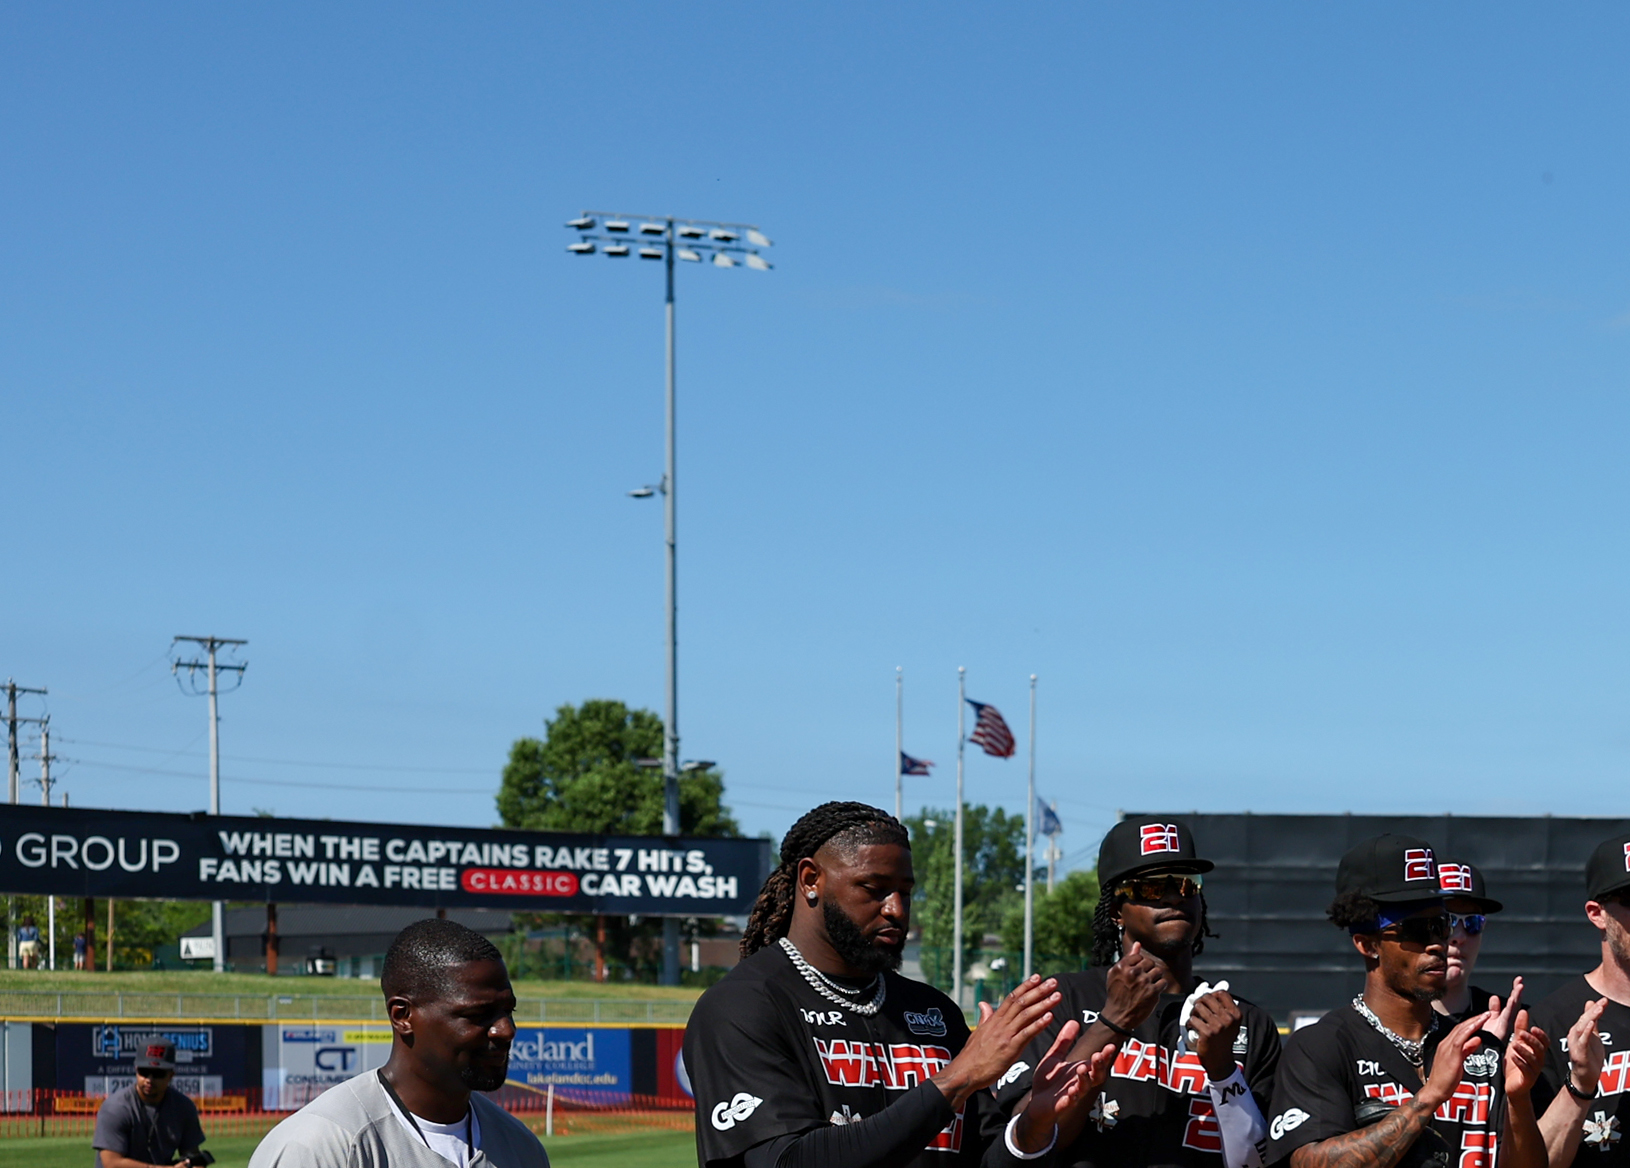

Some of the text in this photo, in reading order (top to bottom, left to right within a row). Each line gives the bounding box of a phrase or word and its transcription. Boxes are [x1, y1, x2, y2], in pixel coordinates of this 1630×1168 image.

[16, 833, 180, 872] GROUP
[218, 831, 713, 876] WHEN THE CAPTAINS RAKE 7 HITS,
[200, 858, 738, 899] FANS WIN A FREE CLASSIC CAR WASH
[509, 1032, 595, 1062] keland
[1111, 1037, 1212, 1095] WAR
[1357, 1060, 1385, 1076] DTL
